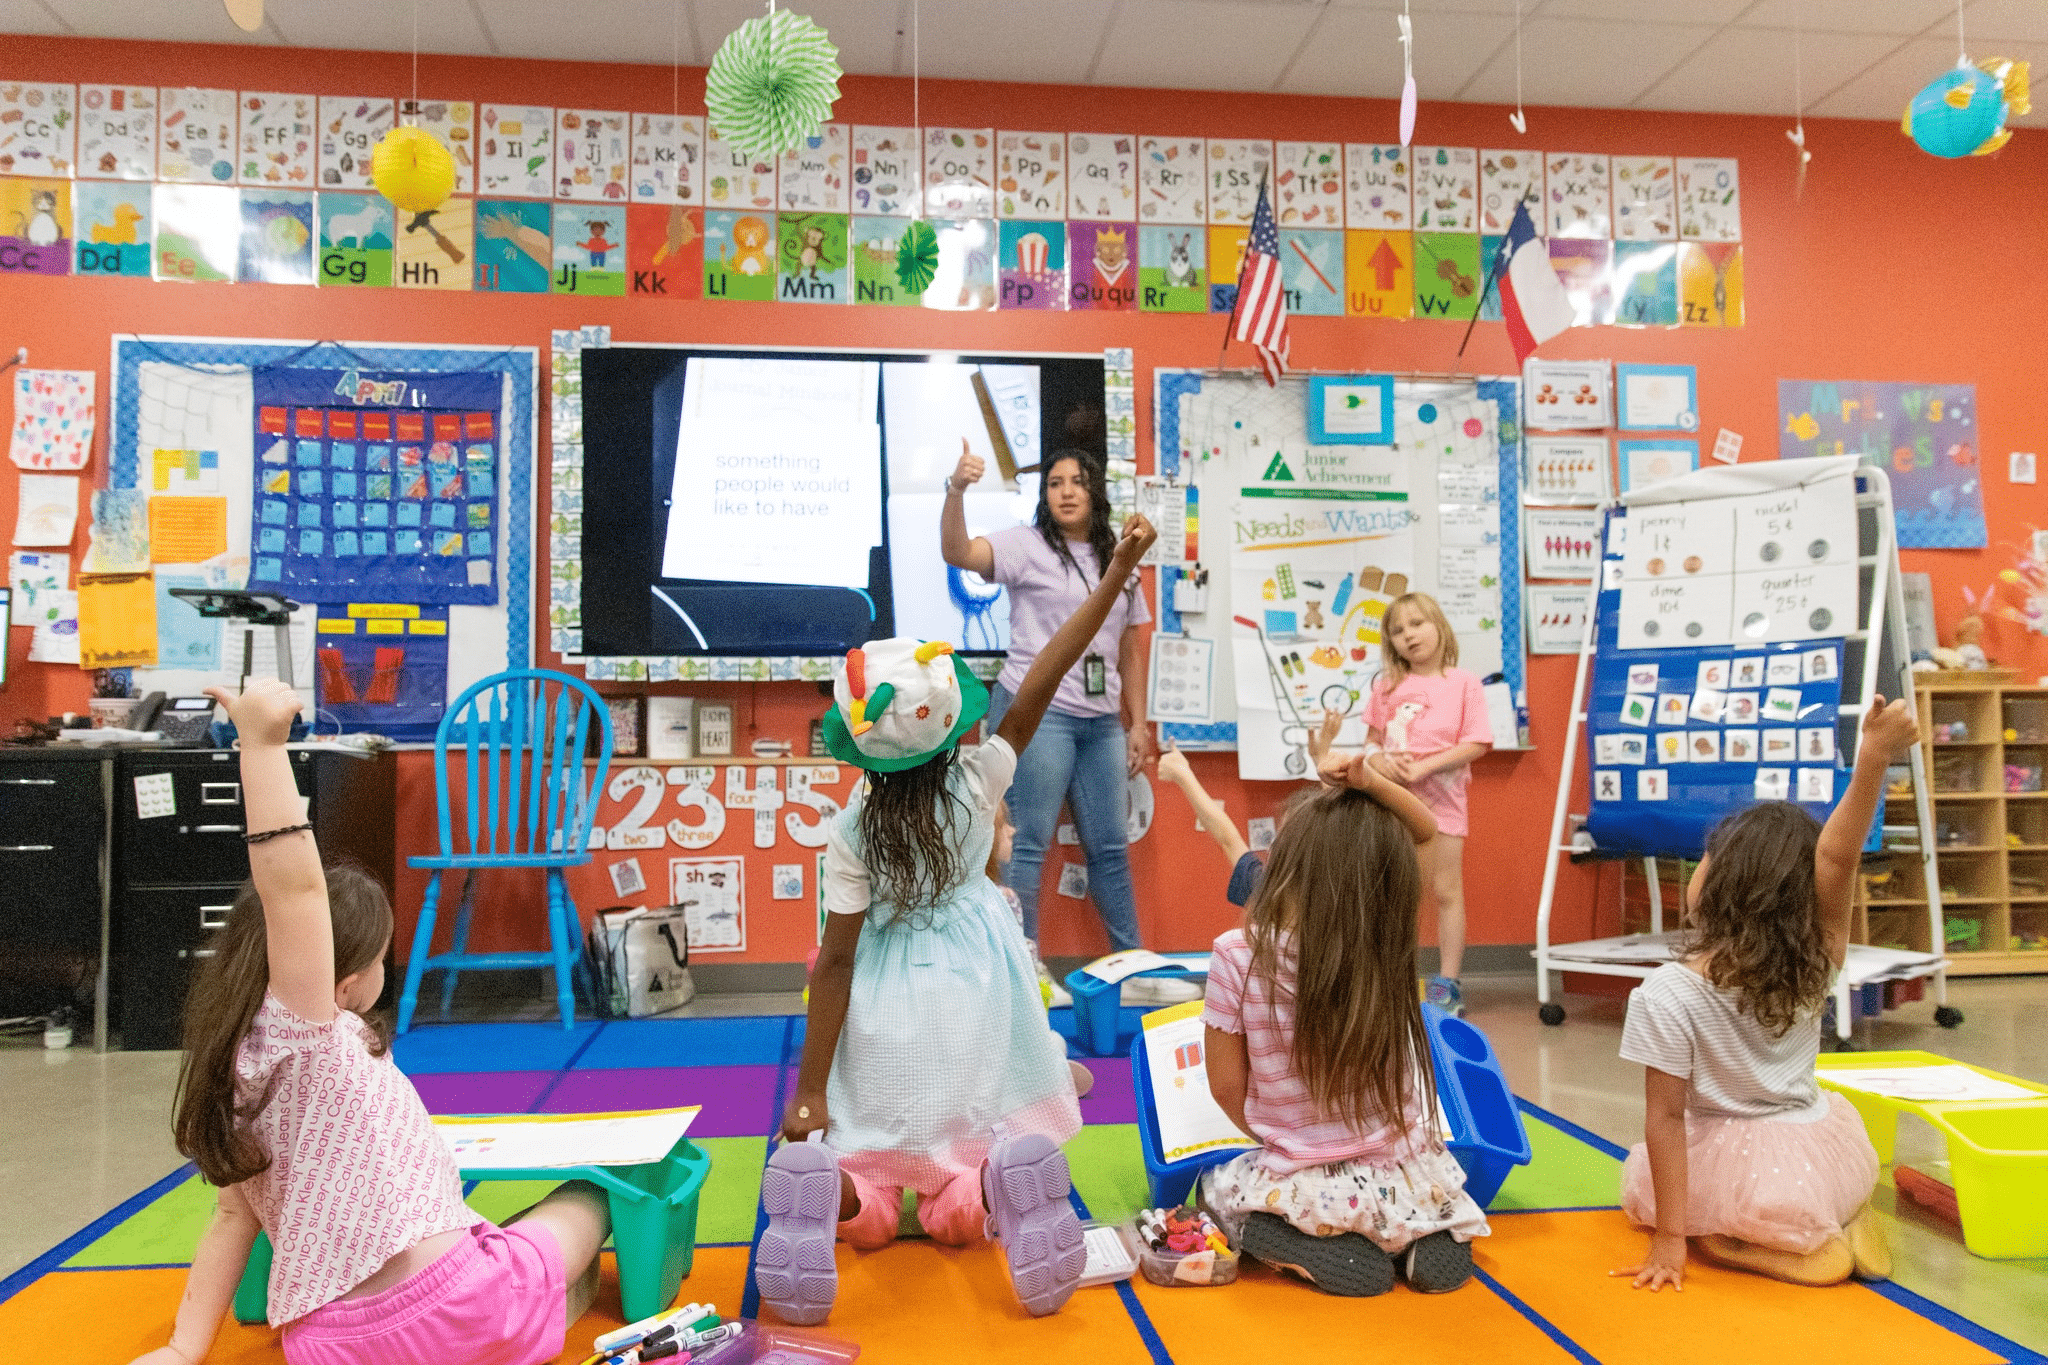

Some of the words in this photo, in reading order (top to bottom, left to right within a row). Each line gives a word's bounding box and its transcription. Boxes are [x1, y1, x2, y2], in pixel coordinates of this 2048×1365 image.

[24, 120, 49, 138] Cc
[104, 121, 128, 137] Dd
[185, 125, 208, 140] Ee
[264, 127, 287, 144] Ff
[344, 131, 367, 150] Gg
[586, 143, 601, 165] Jj
[655, 146, 676, 163] Kk
[801, 159, 825, 172] Mm
[875, 160, 898, 175] Nn
[944, 161, 968, 176] Oo
[1018, 158, 1042, 177] Pp
[1086, 163, 1109, 181] Qq
[1160, 168, 1182, 185] Rr
[1228, 168, 1250, 186] Ss
[1299, 174, 1317, 192] Tt
[1366, 170, 1386, 186] Uu
[1432, 173, 1455, 189] Vv
[1565, 181, 1587, 196] Xx
[1631, 184, 1651, 200] Yy
[1698, 188, 1718, 204] Zz
[0, 246, 41, 271] Cc
[80, 248, 121, 273] Dd
[161, 251, 196, 277] Ee
[322, 254, 367, 284] Gg
[402, 262, 439, 285] Hh
[478, 263, 500, 288] Ii
[556, 263, 578, 291] Jj
[634, 271, 668, 294] Kk
[709, 273, 726, 296] Ll
[782, 277, 835, 299] Mm
[857, 280, 894, 301] Nn
[1002, 279, 1034, 302] Pp
[1072, 282, 1103, 302] Qu
[1108, 286, 1135, 306] qu
[1145, 288, 1167, 308] Rr
[1284, 290, 1302, 310] Tt
[1351, 291, 1382, 313] Uu
[1419, 293, 1450, 315] Vv
[1684, 301, 1709, 323] Zz
[334, 370, 407, 405] April
[715, 453, 821, 473] something
[1303, 450, 1348, 467] Junior
[714, 473, 786, 495] people
[791, 476, 850, 494] would
[1303, 468, 1393, 486] Achievement
[713, 498, 750, 516] like
[753, 499, 775, 516] to
[781, 499, 830, 516] have
[1754, 499, 1799, 516] nickel
[1234, 512, 1305, 544] Needs
[1324, 508, 1412, 533] Wants
[1640, 515, 1687, 534] penny
[1650, 584, 1685, 599] dime
[1761, 572, 1815, 600] quarter
[1706, 667, 1719, 684] 6
[702, 731, 729, 748] HEART
[811, 768, 835, 781] five
[607, 766, 666, 850] 2
[666, 766, 726, 849] 3
[725, 766, 784, 848] 4
[729, 793, 756, 805] four
[785, 766, 841, 848] 5
[623, 831, 648, 846] two
[677, 828, 715, 843] three
[685, 869, 704, 885] sh
[268, 1024, 316, 1040] Calvin
[310, 1077, 336, 1125] Calvin
[276, 1106, 291, 1147] Jeans
[335, 1098, 361, 1144] Calvin
[295, 1129, 318, 1164] Klein
[275, 1150, 289, 1181] Klein
[322, 1147, 344, 1181] Klein
[309, 1183, 330, 1228] Jeans
[341, 1174, 366, 1222] Calvin
[369, 1181, 395, 1229] Calvin
[273, 1255, 291, 1298] Jeans
[282, 1207, 307, 1253] Calvin
[296, 1168, 319, 1204] Klein
[310, 1121, 335, 1166] Jeans
[309, 1241, 329, 1277] Klein
[322, 1195, 342, 1241] Jeans
[335, 1146, 360, 1193] Calvin
[335, 1257, 354, 1292] Klein
[346, 1210, 368, 1256] Jeans
[361, 1160, 385, 1208] Calvin
[332, 1224, 349, 1259] Klein
[358, 1231, 377, 1267] Klein
[371, 1217, 393, 1264] Jeans
[292, 1231, 317, 1279] Calvin
[315, 1261, 337, 1305] Jeans
[281, 1281, 302, 1315] Klein
